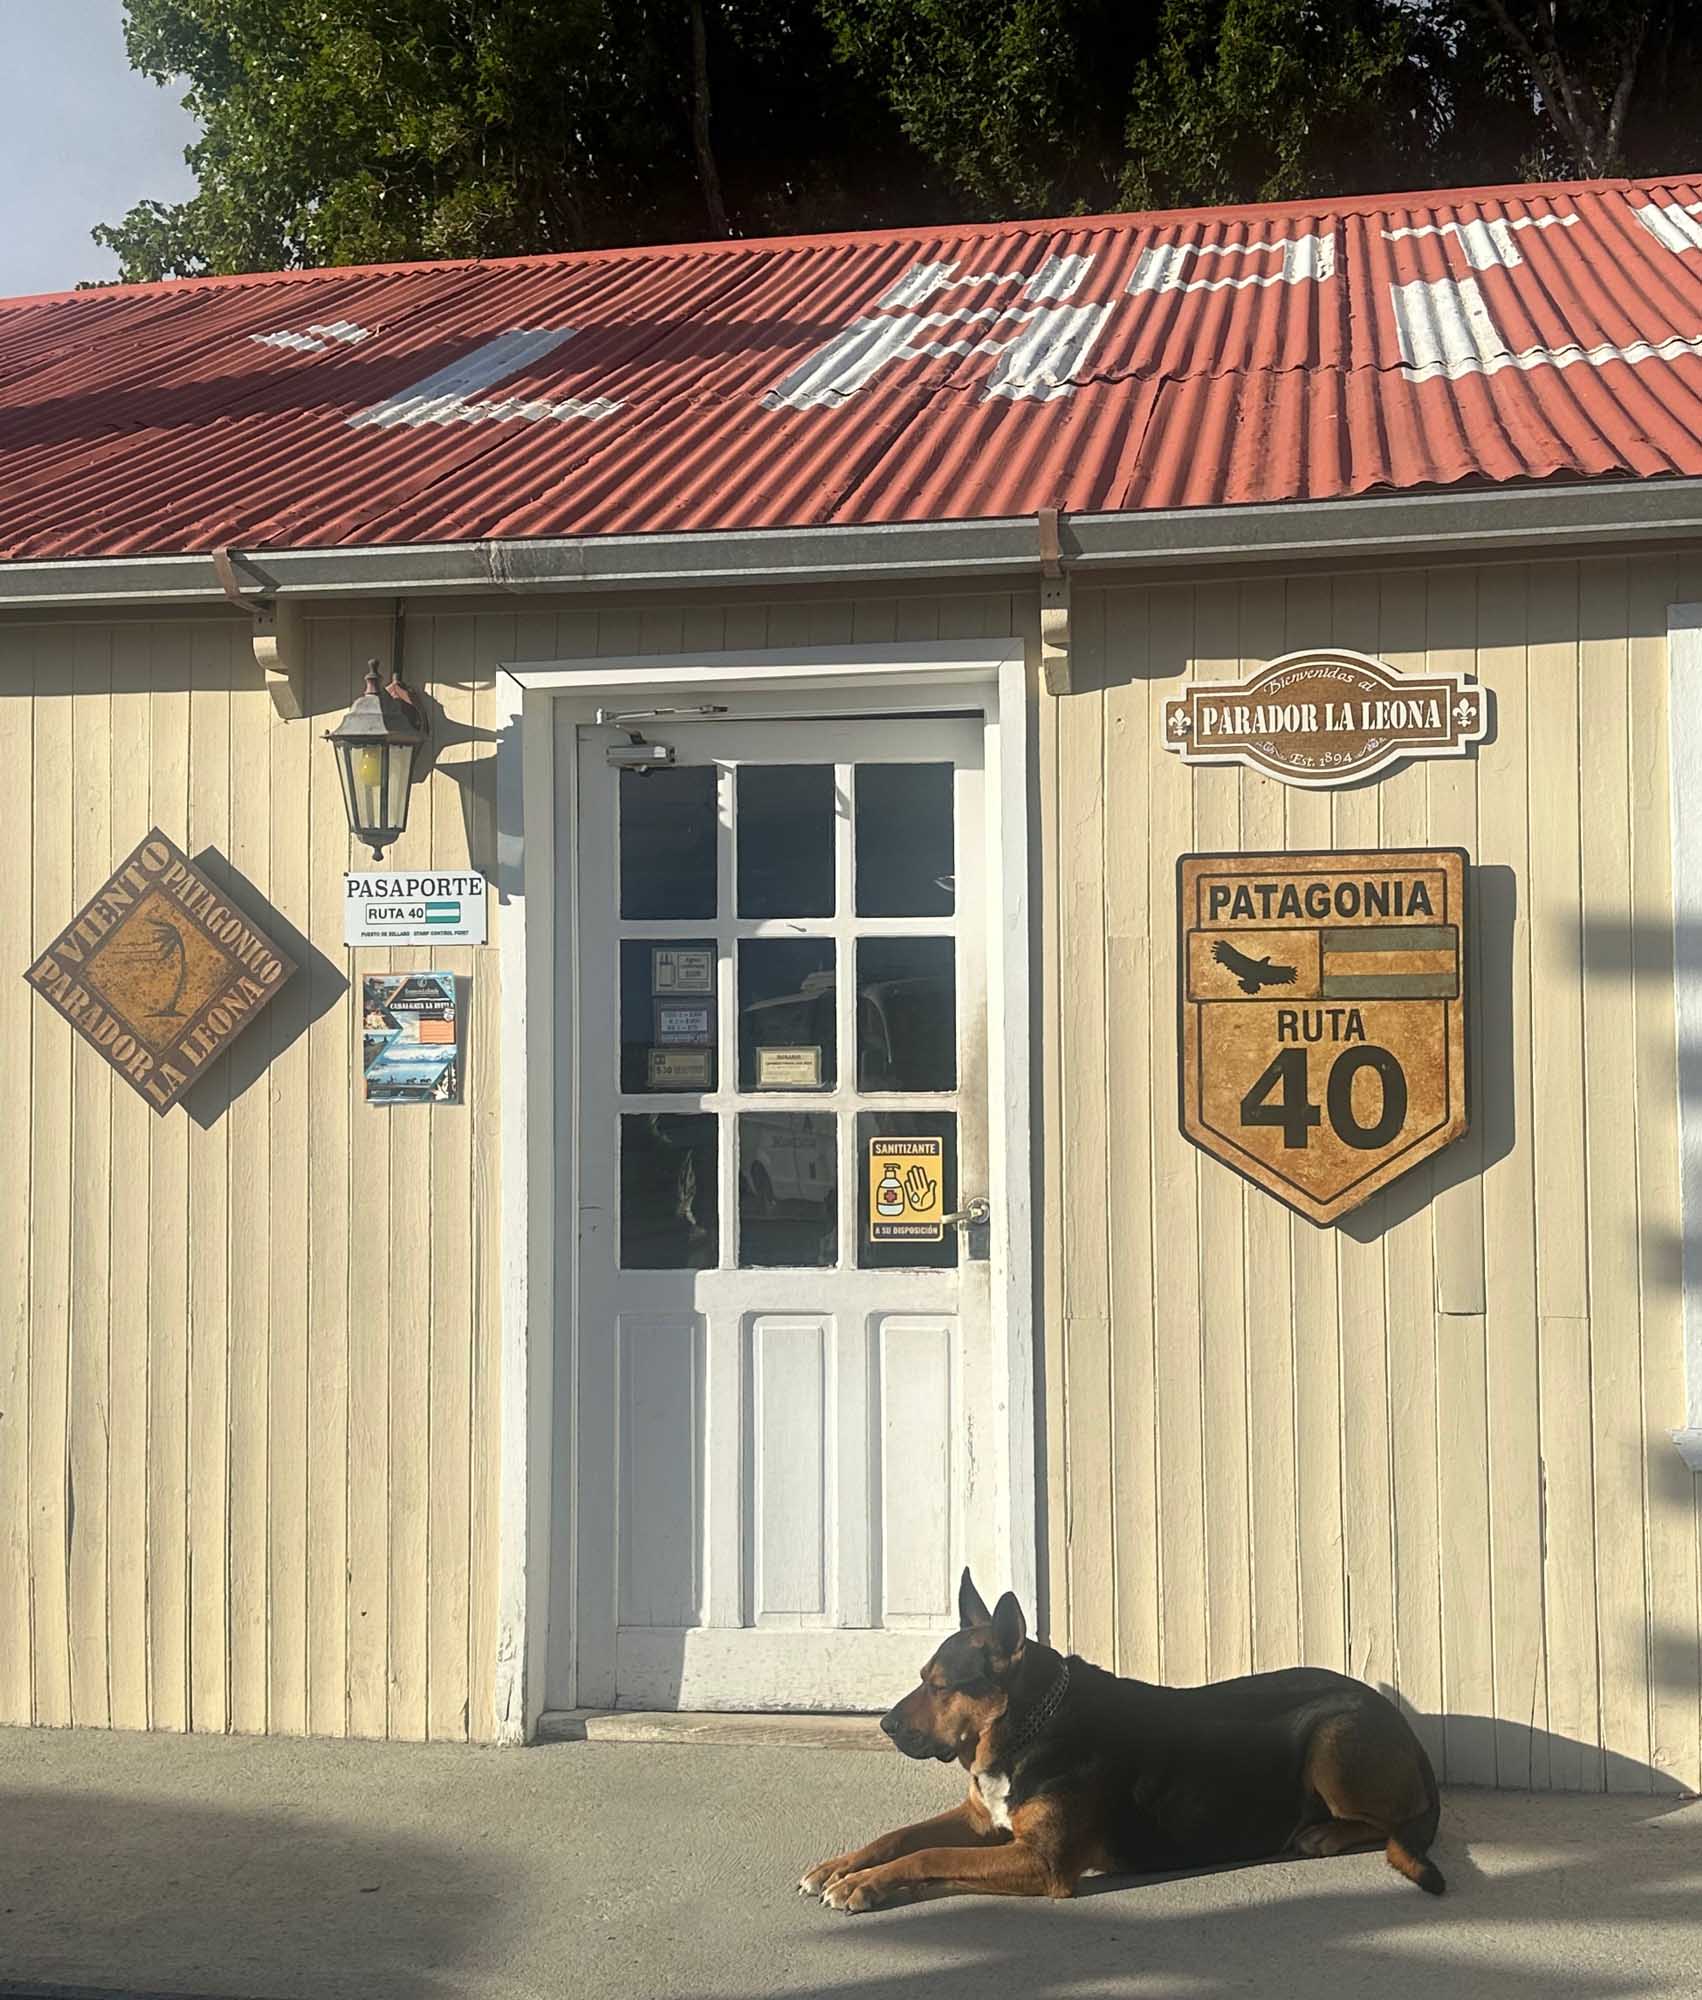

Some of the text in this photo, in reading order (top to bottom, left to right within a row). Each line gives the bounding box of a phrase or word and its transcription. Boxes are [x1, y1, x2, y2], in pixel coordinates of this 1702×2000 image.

[1264, 667, 1377, 696] Bienvenidos al
[1202, 699, 1442, 736] PARADOR LA LEONA
[1289, 752, 1352, 767] Est. 1894
[55, 841, 170, 962] VIENTO
[347, 877, 482, 898] PASAPORTE
[1209, 880, 1434, 920] PATAGONIA
[161, 860, 282, 984] PATAGONICO
[368, 907, 424, 919] RUTA 40
[31, 955, 154, 1082] PARADOR
[1277, 1008, 1367, 1042] RUTA
[144, 976, 265, 1106] LA LEONA
[1240, 1044, 1408, 1150] 40
[875, 1143, 936, 1154] SANITIZANTE
[875, 1225, 938, 1235] A SU DISPOSICIÓN
